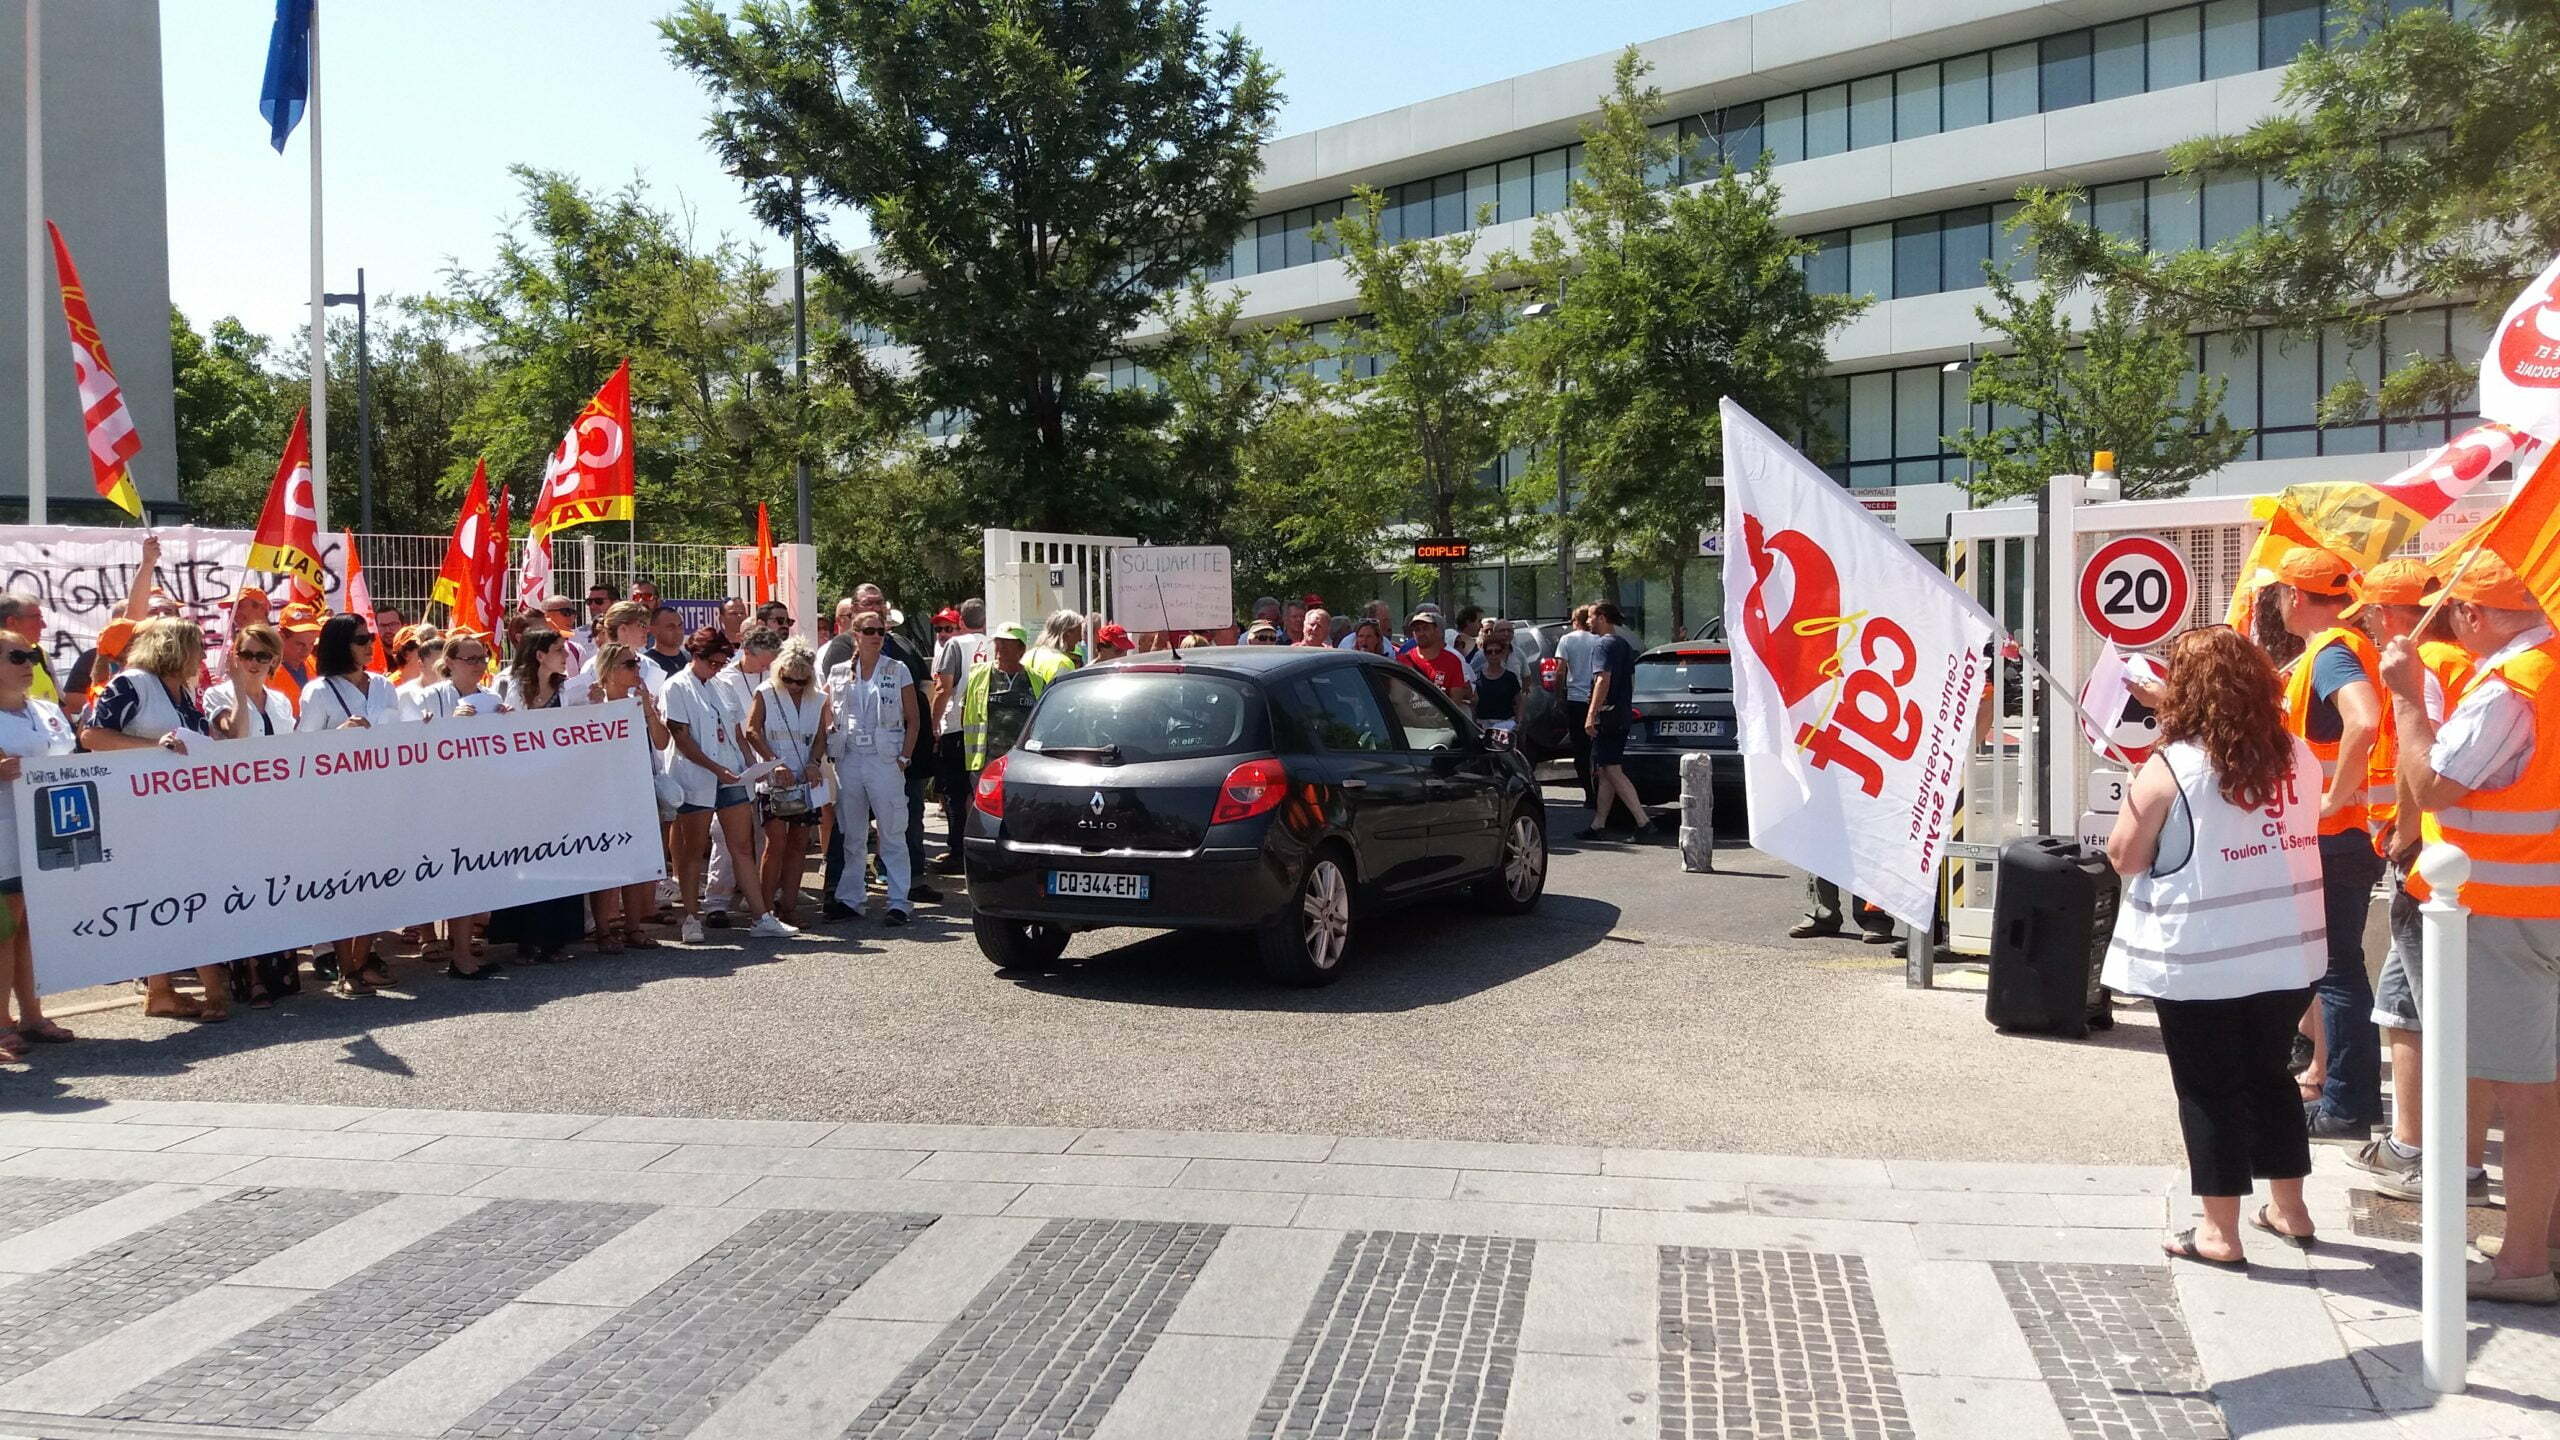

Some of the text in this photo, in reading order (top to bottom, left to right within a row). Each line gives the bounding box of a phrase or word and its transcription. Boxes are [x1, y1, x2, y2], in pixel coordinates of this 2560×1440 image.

[1418, 546, 1467, 557] COMPLET
[2104, 569, 2168, 615] 20
[130, 719, 629, 796] URGENCES / SAMU DU CHITS EN GRÈVE
[1078, 820, 1117, 829] CLIO
[2221, 842, 2267, 862] Toulon
[72, 892, 207, 937] «STOP
[224, 885, 257, 914] à
[415, 854, 444, 882] à
[451, 830, 632, 876] humains»
[1141, 887, 1149, 898] 13
